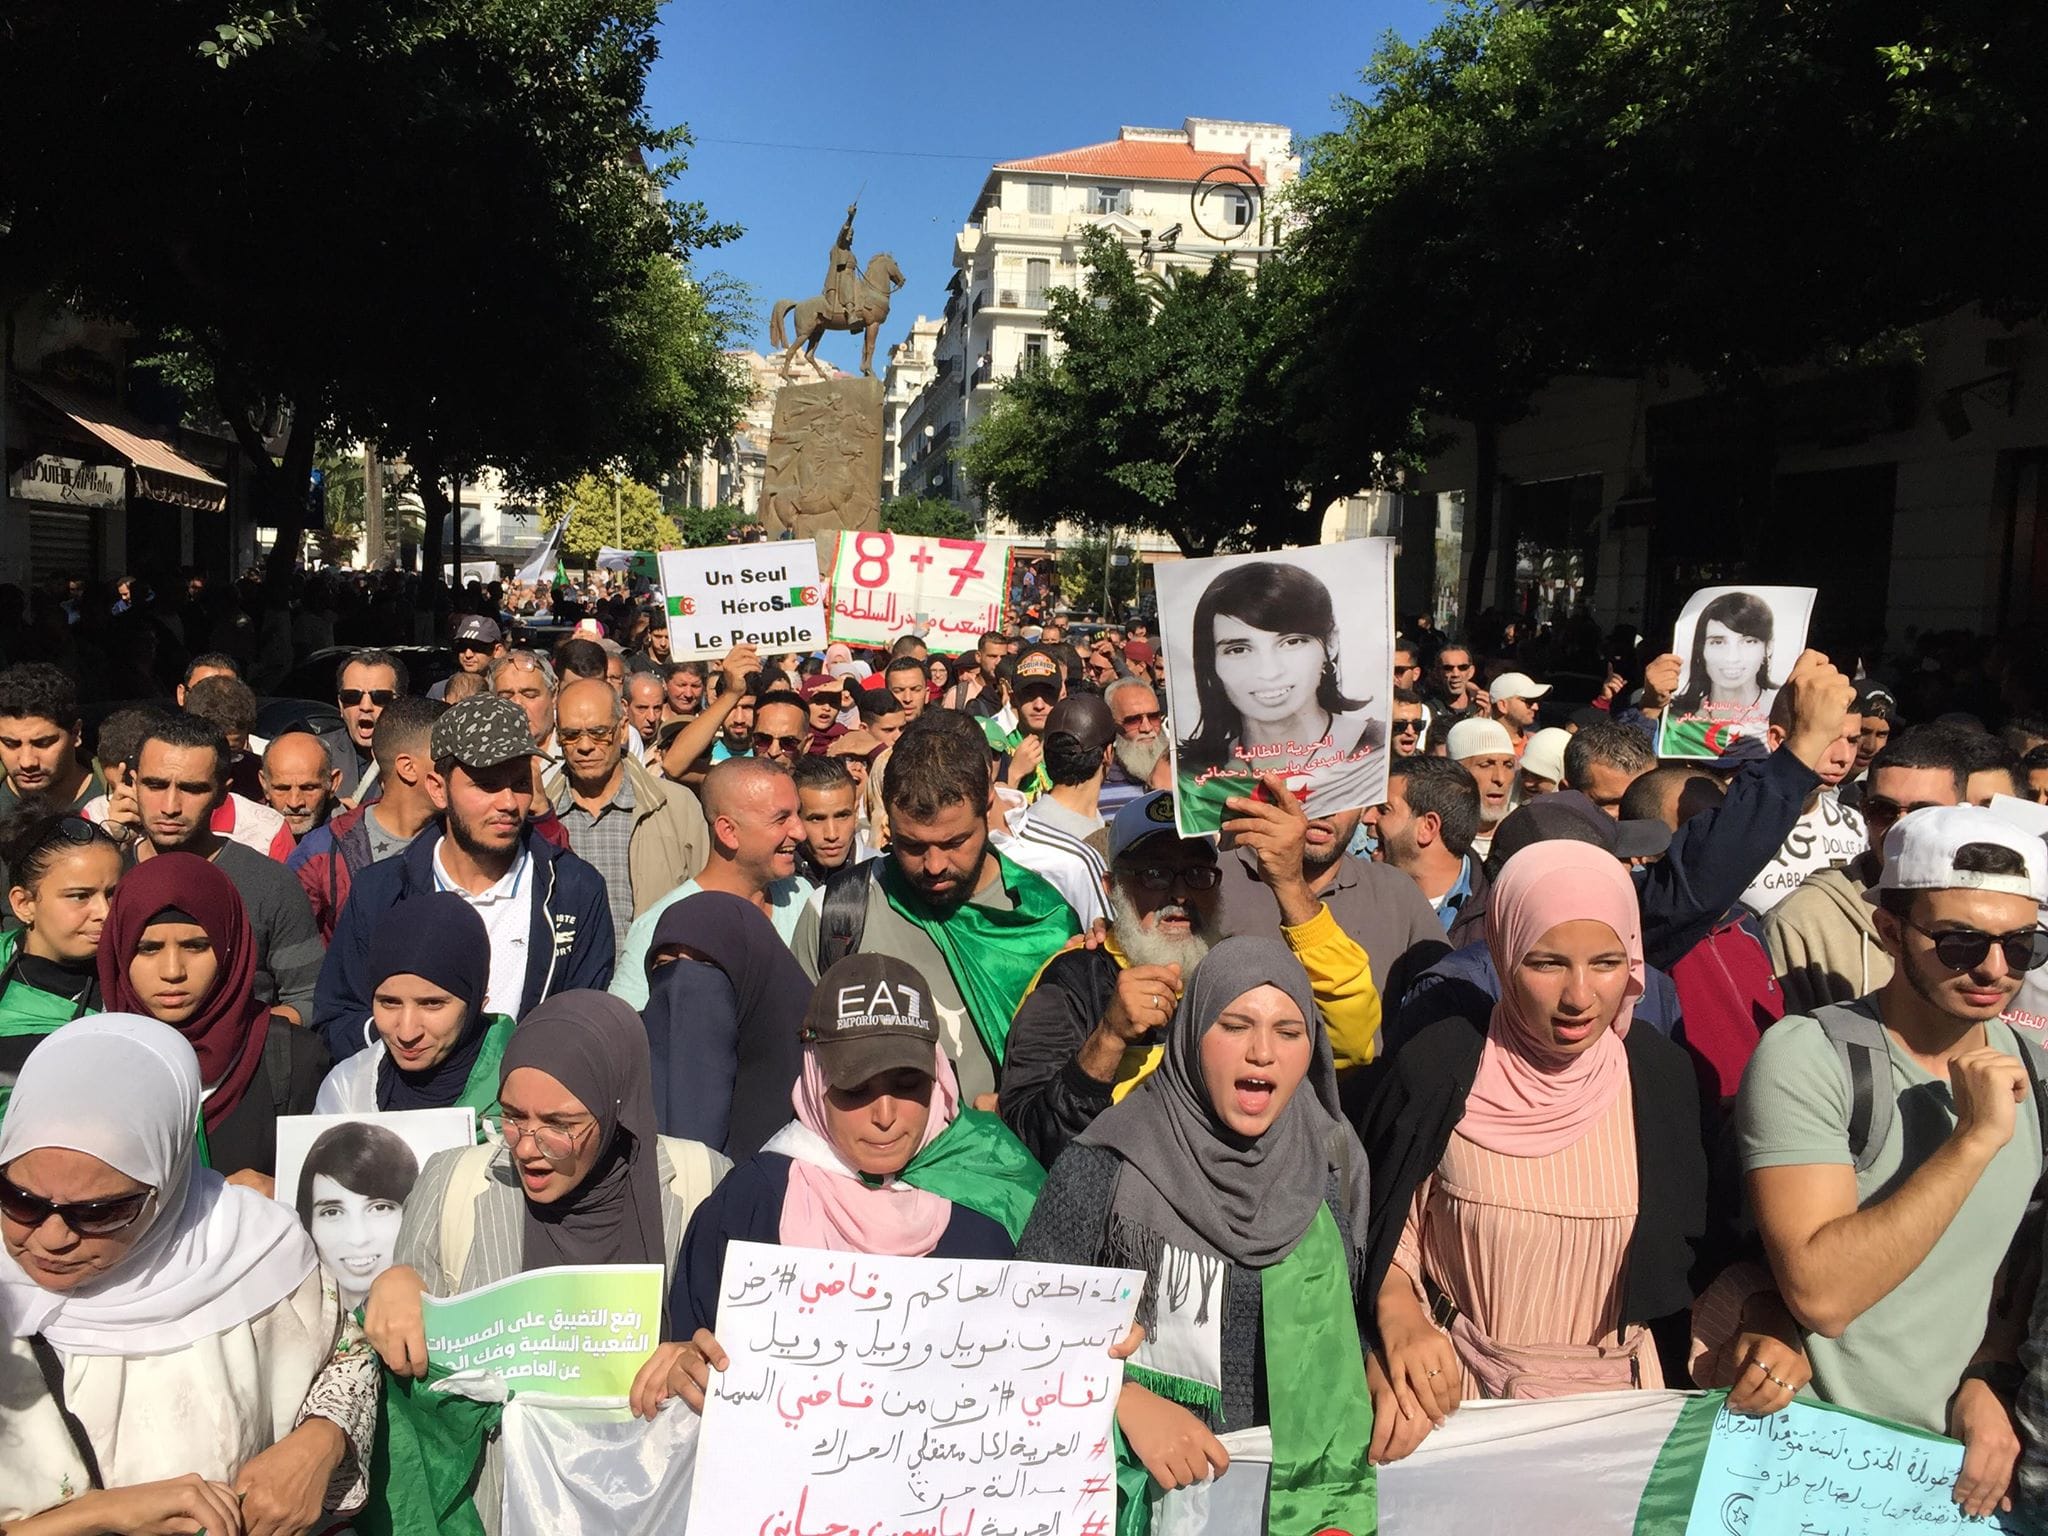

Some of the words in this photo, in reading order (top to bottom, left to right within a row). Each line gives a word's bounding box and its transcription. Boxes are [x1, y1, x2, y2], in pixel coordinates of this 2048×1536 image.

[853, 531, 895, 588] 8
[910, 546, 934, 573] +
[939, 538, 987, 596] 7
[705, 571, 734, 586] Un
[740, 566, 788, 584] Seul
[835, 589, 896, 623] السلطة
[888, 613, 937, 631] مدر
[939, 602, 999, 638] الشعب
[694, 632, 723, 648] Le
[731, 626, 812, 647] Peuple
[1234, 745, 1282, 762] للطالبة
[1286, 735, 1333, 755] الحرية
[1348, 745, 1371, 763] نور
[1305, 751, 1345, 772] الهدى
[1194, 765, 1248, 785] دحماني
[1763, 872, 1808, 890] GABB
[838, 980, 920, 1019] EA7
[836, 1015, 879, 1031] EMPORIO
[895, 1015, 930, 1031] ARMANI
[1999, 1010, 2046, 1030] للطالب
[508, 1310, 546, 1334] على
[549, 1308, 608, 1332] التضييق
[611, 1308, 641, 1332] رفع
[427, 1319, 504, 1353] المسيرات
[519, 1334, 579, 1355] السلمية
[583, 1332, 649, 1357] الشعبية
[473, 1342, 516, 1366] وفك
[495, 1359, 557, 1379] العاصمة
[558, 1362, 581, 1379] عن
[714, 1367, 776, 1406] السماء
[777, 1372, 874, 1431] قاضي
[881, 1391, 927, 1419] من
[811, 1428, 904, 1476] الحراك
[1010, 1431, 1081, 1467] الحرية
[1727, 1465, 1800, 1496] طرف
